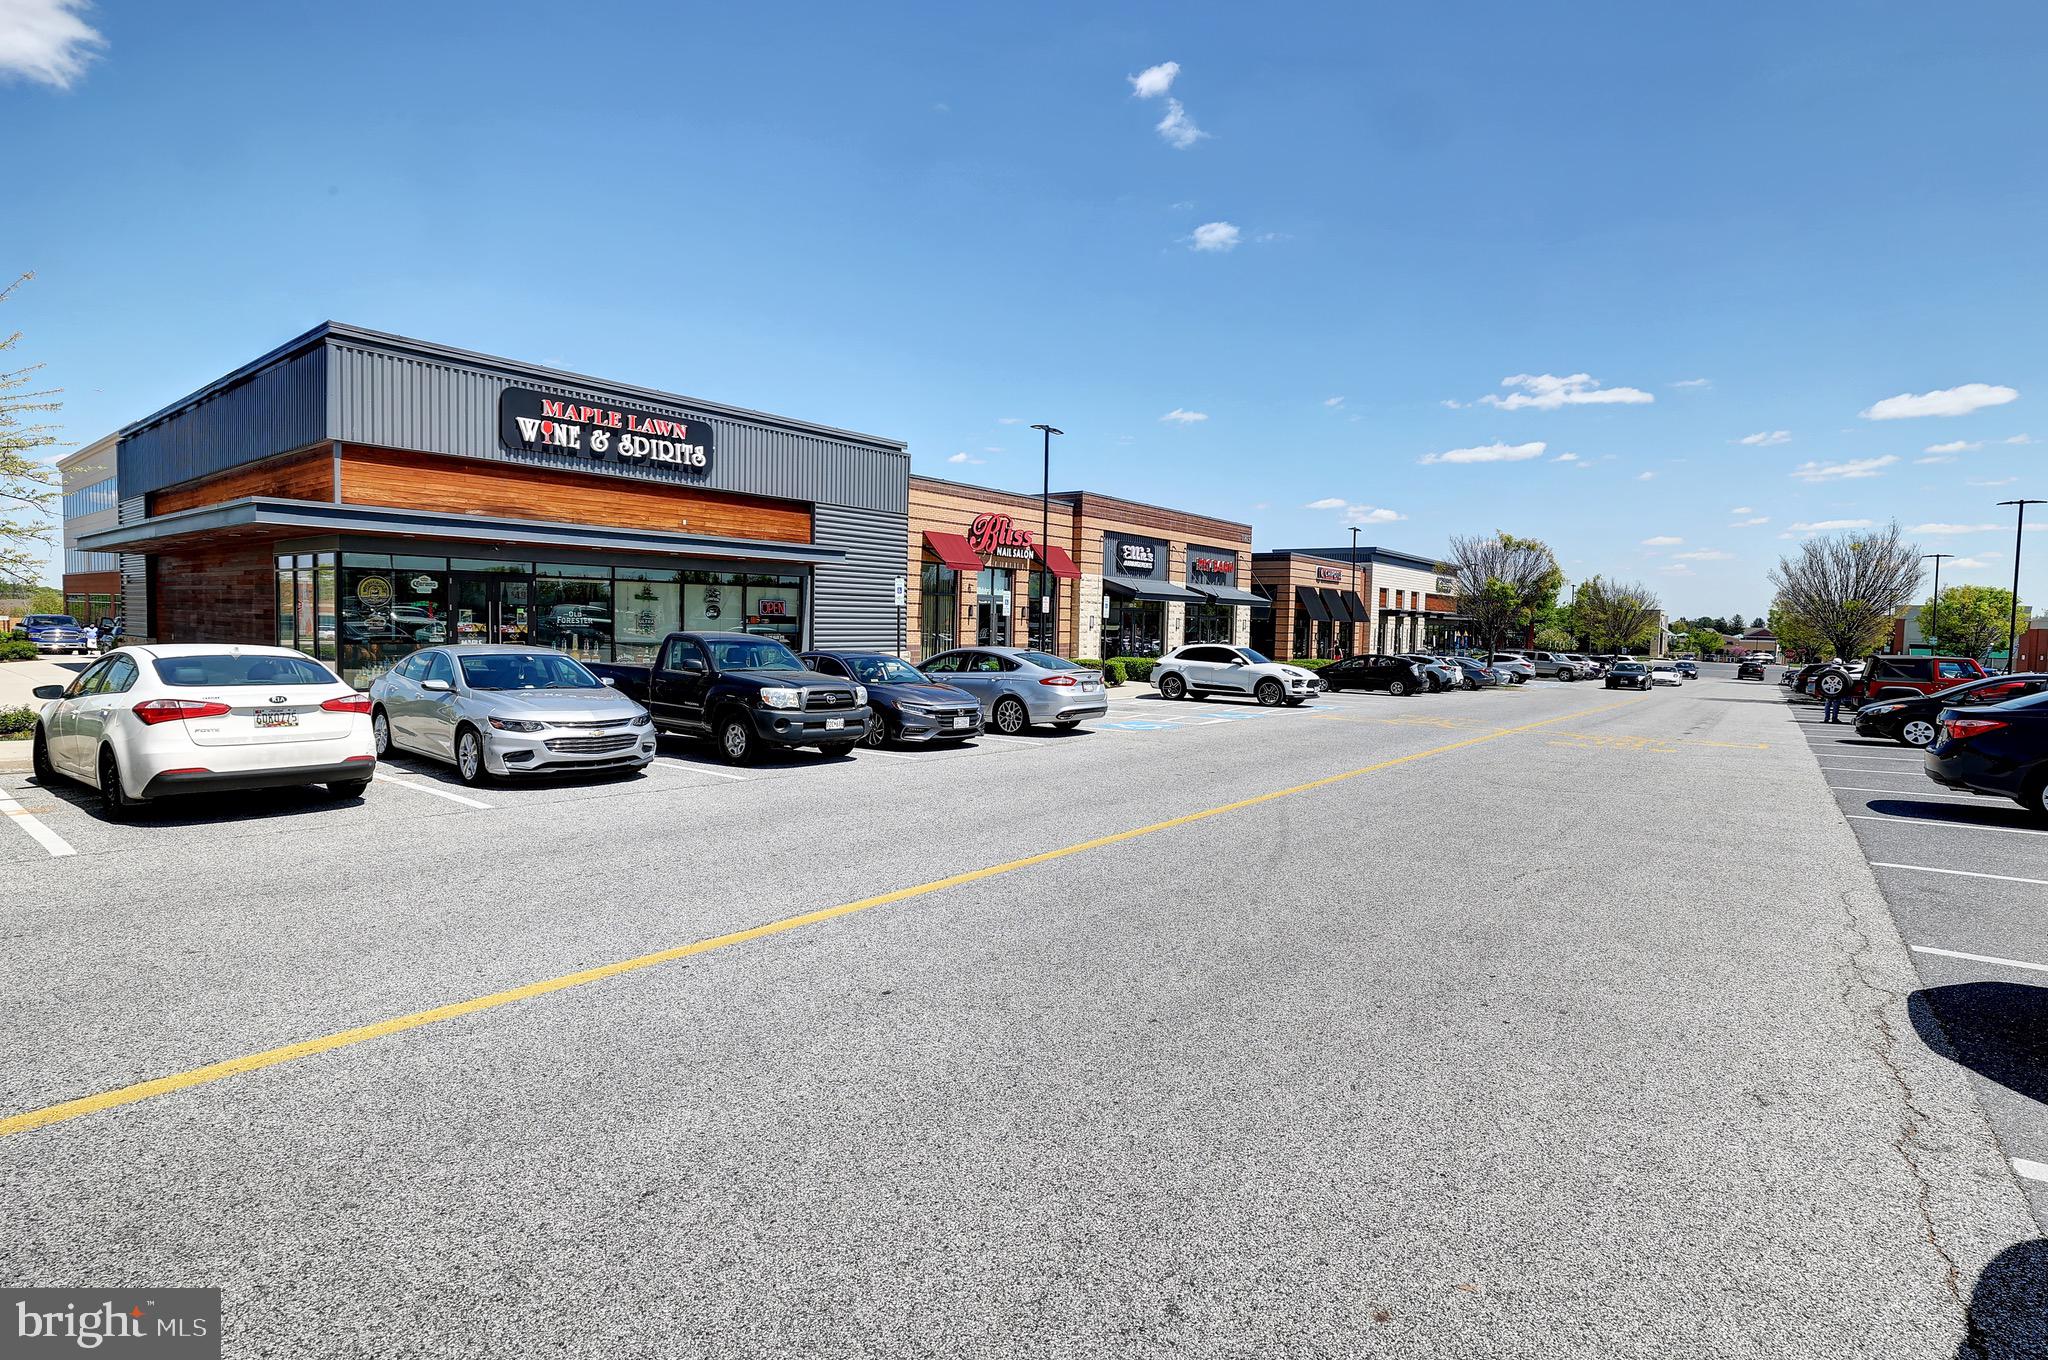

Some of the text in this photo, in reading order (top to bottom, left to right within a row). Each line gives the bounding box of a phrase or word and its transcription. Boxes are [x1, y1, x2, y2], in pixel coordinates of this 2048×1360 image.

[541, 399, 688, 440] MAPLE LAWN
[516, 417, 706, 467] WINE & SPIRITS
[969, 512, 1034, 553] Bliss
[996, 546, 1035, 560] NAIL SALON
[568, 610, 583, 618] OLD
[761, 602, 785, 614] OPEN
[556, 615, 593, 624] FORESTER
